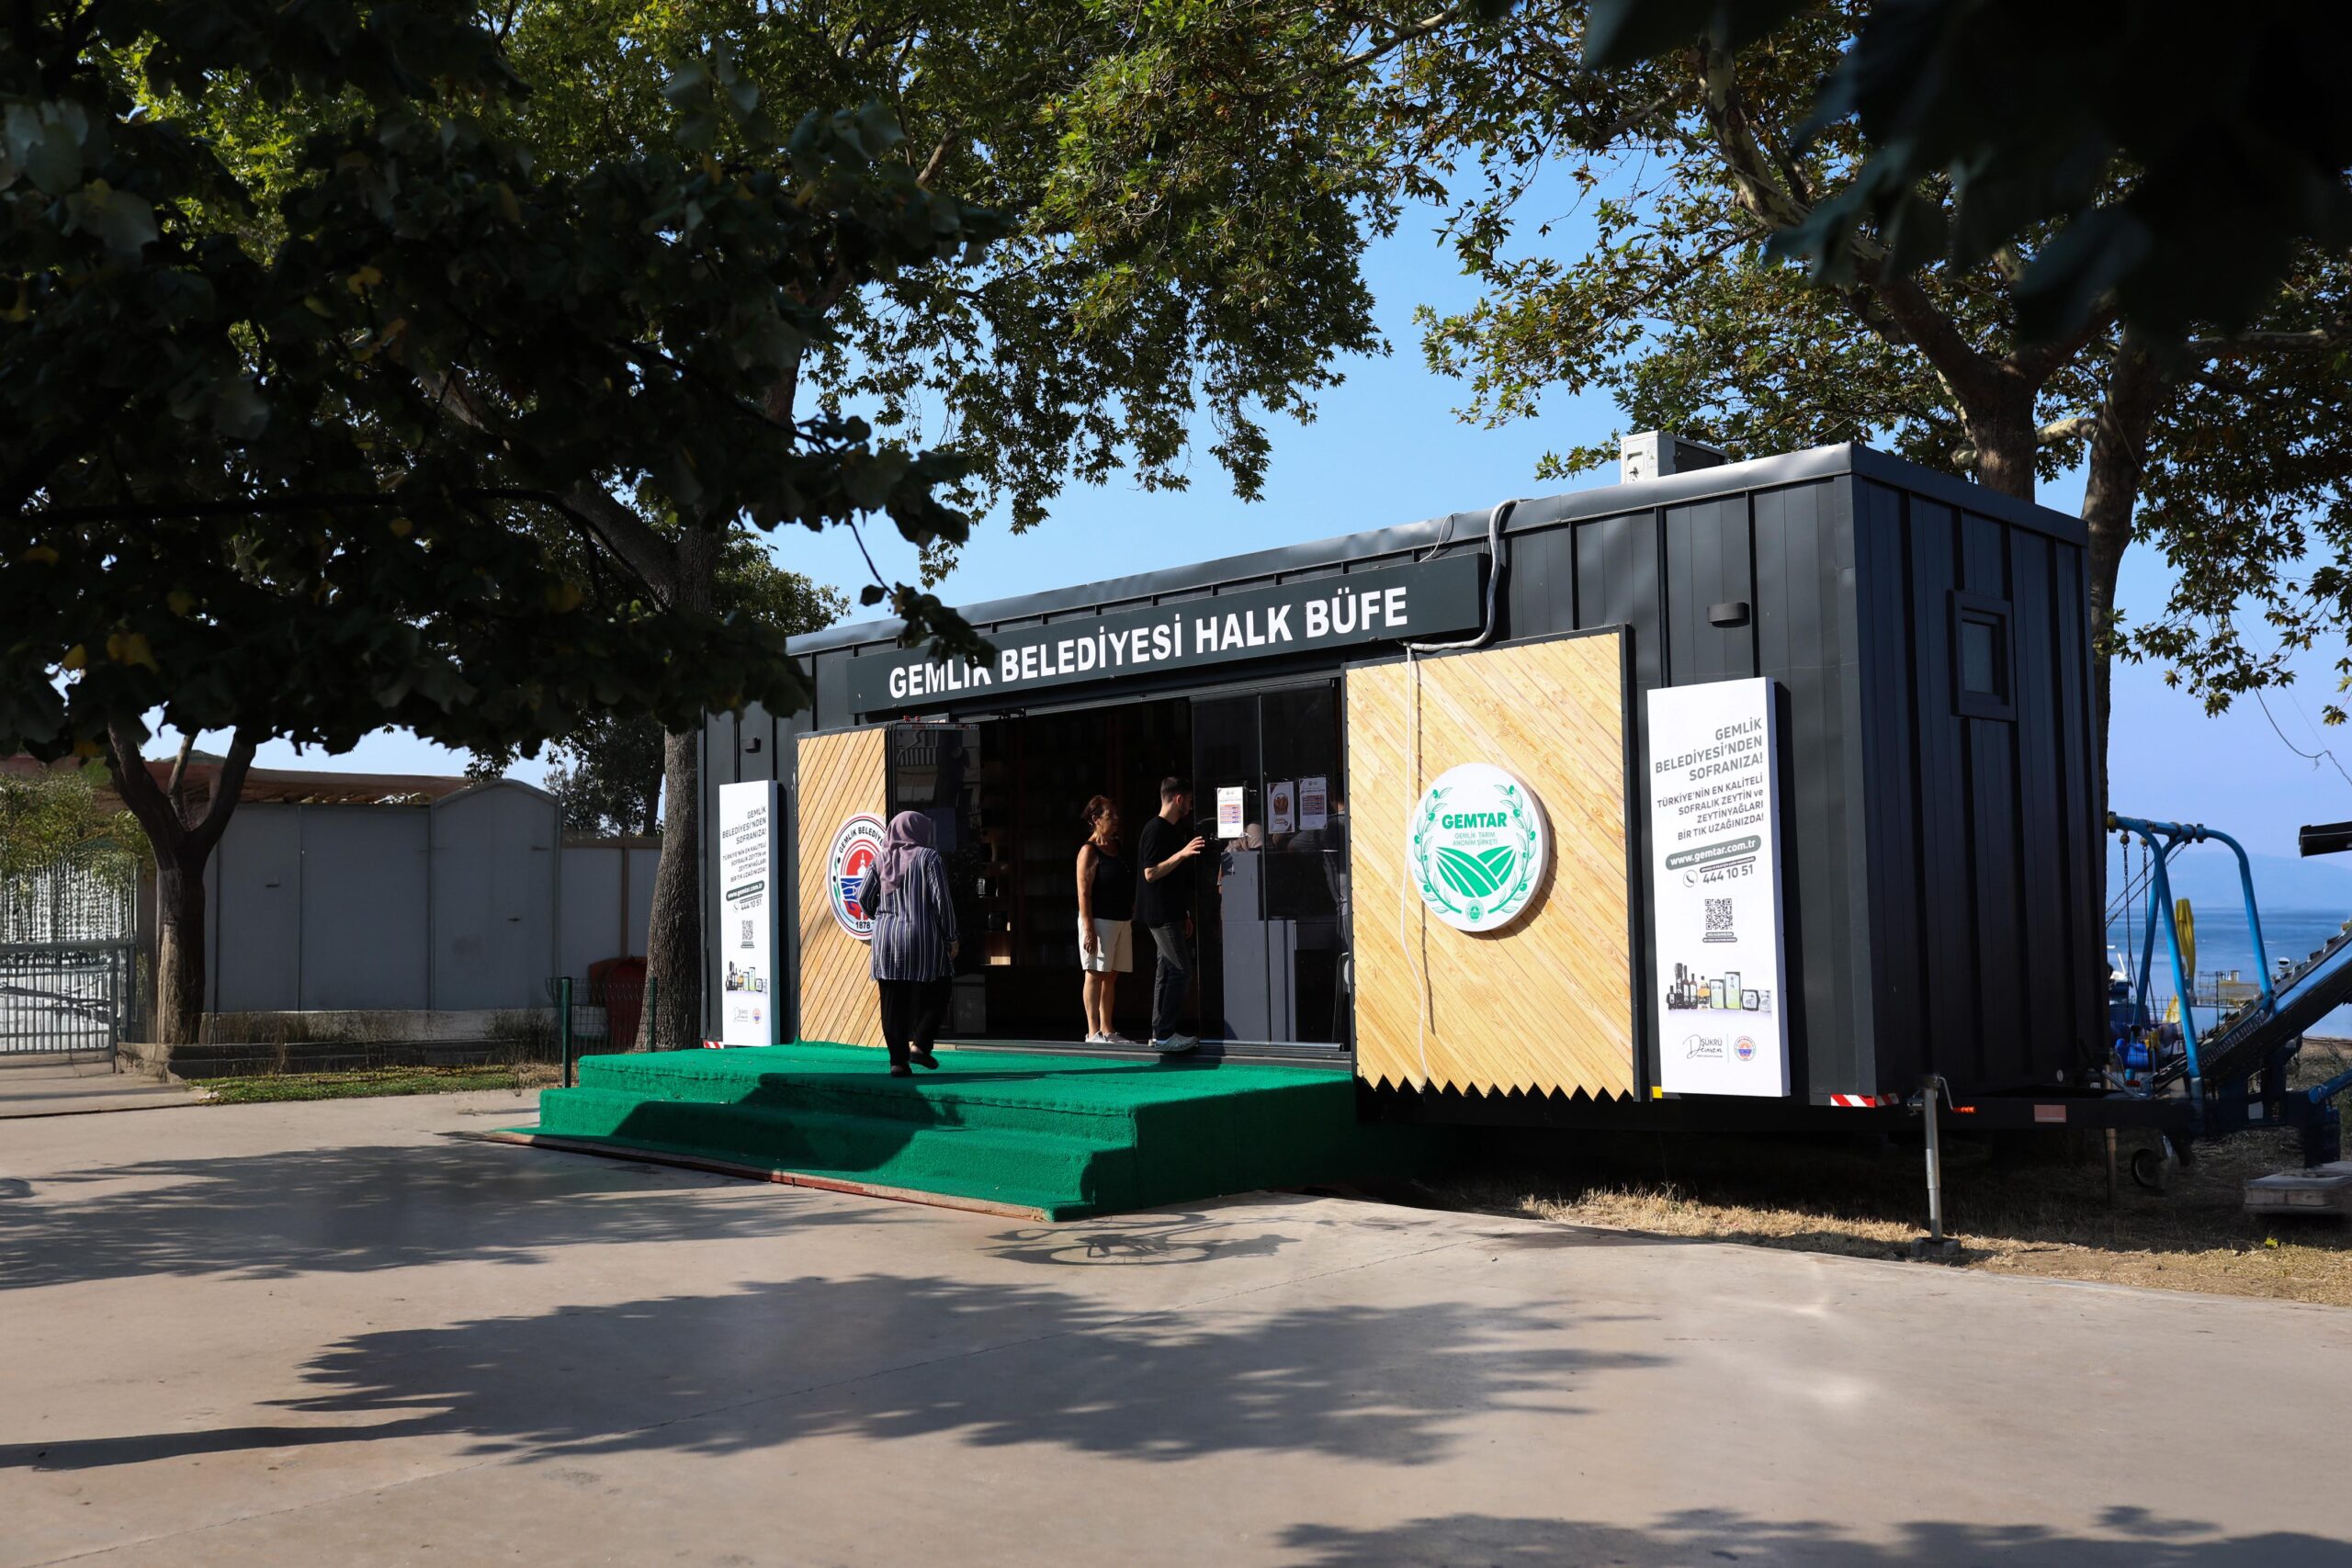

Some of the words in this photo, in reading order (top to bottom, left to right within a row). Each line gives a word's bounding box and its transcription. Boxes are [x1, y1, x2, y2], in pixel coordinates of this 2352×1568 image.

[1001, 614, 1182, 682] BELEDİYESİ
[1196, 604, 1293, 653] HALK
[1306, 586, 1408, 638] BÜFE
[1715, 716, 1762, 740] GEMLİK
[1655, 735, 1762, 773] BELEDİYESİ'NDEN
[1690, 752, 1763, 781] SOFRANIZA!
[1657, 787, 1710, 808] TÜRKİYE'NİN
[1712, 784, 1724, 795] EN
[1725, 773, 1763, 792] KALİTELİ
[1679, 798, 1719, 816] SOFRALIK
[1722, 789, 1752, 806] ZEYTİN
[1442, 812, 1507, 829] GEMTAR
[1697, 800, 1763, 823] ZEYTİNYAĞLARI
[858, 826, 884, 846] BELEDİYE
[1678, 829, 1691, 840] BİR
[1693, 827, 1706, 837] TIK
[1708, 812, 1764, 833] UZAĞINIZDA!
[1670, 840, 1756, 865] www.gemtar.com.tr
[1703, 870, 1724, 884] 444
[1726, 867, 1738, 879] 10
[1742, 863, 1753, 876] 51
[855, 920, 871, 929] 1878
